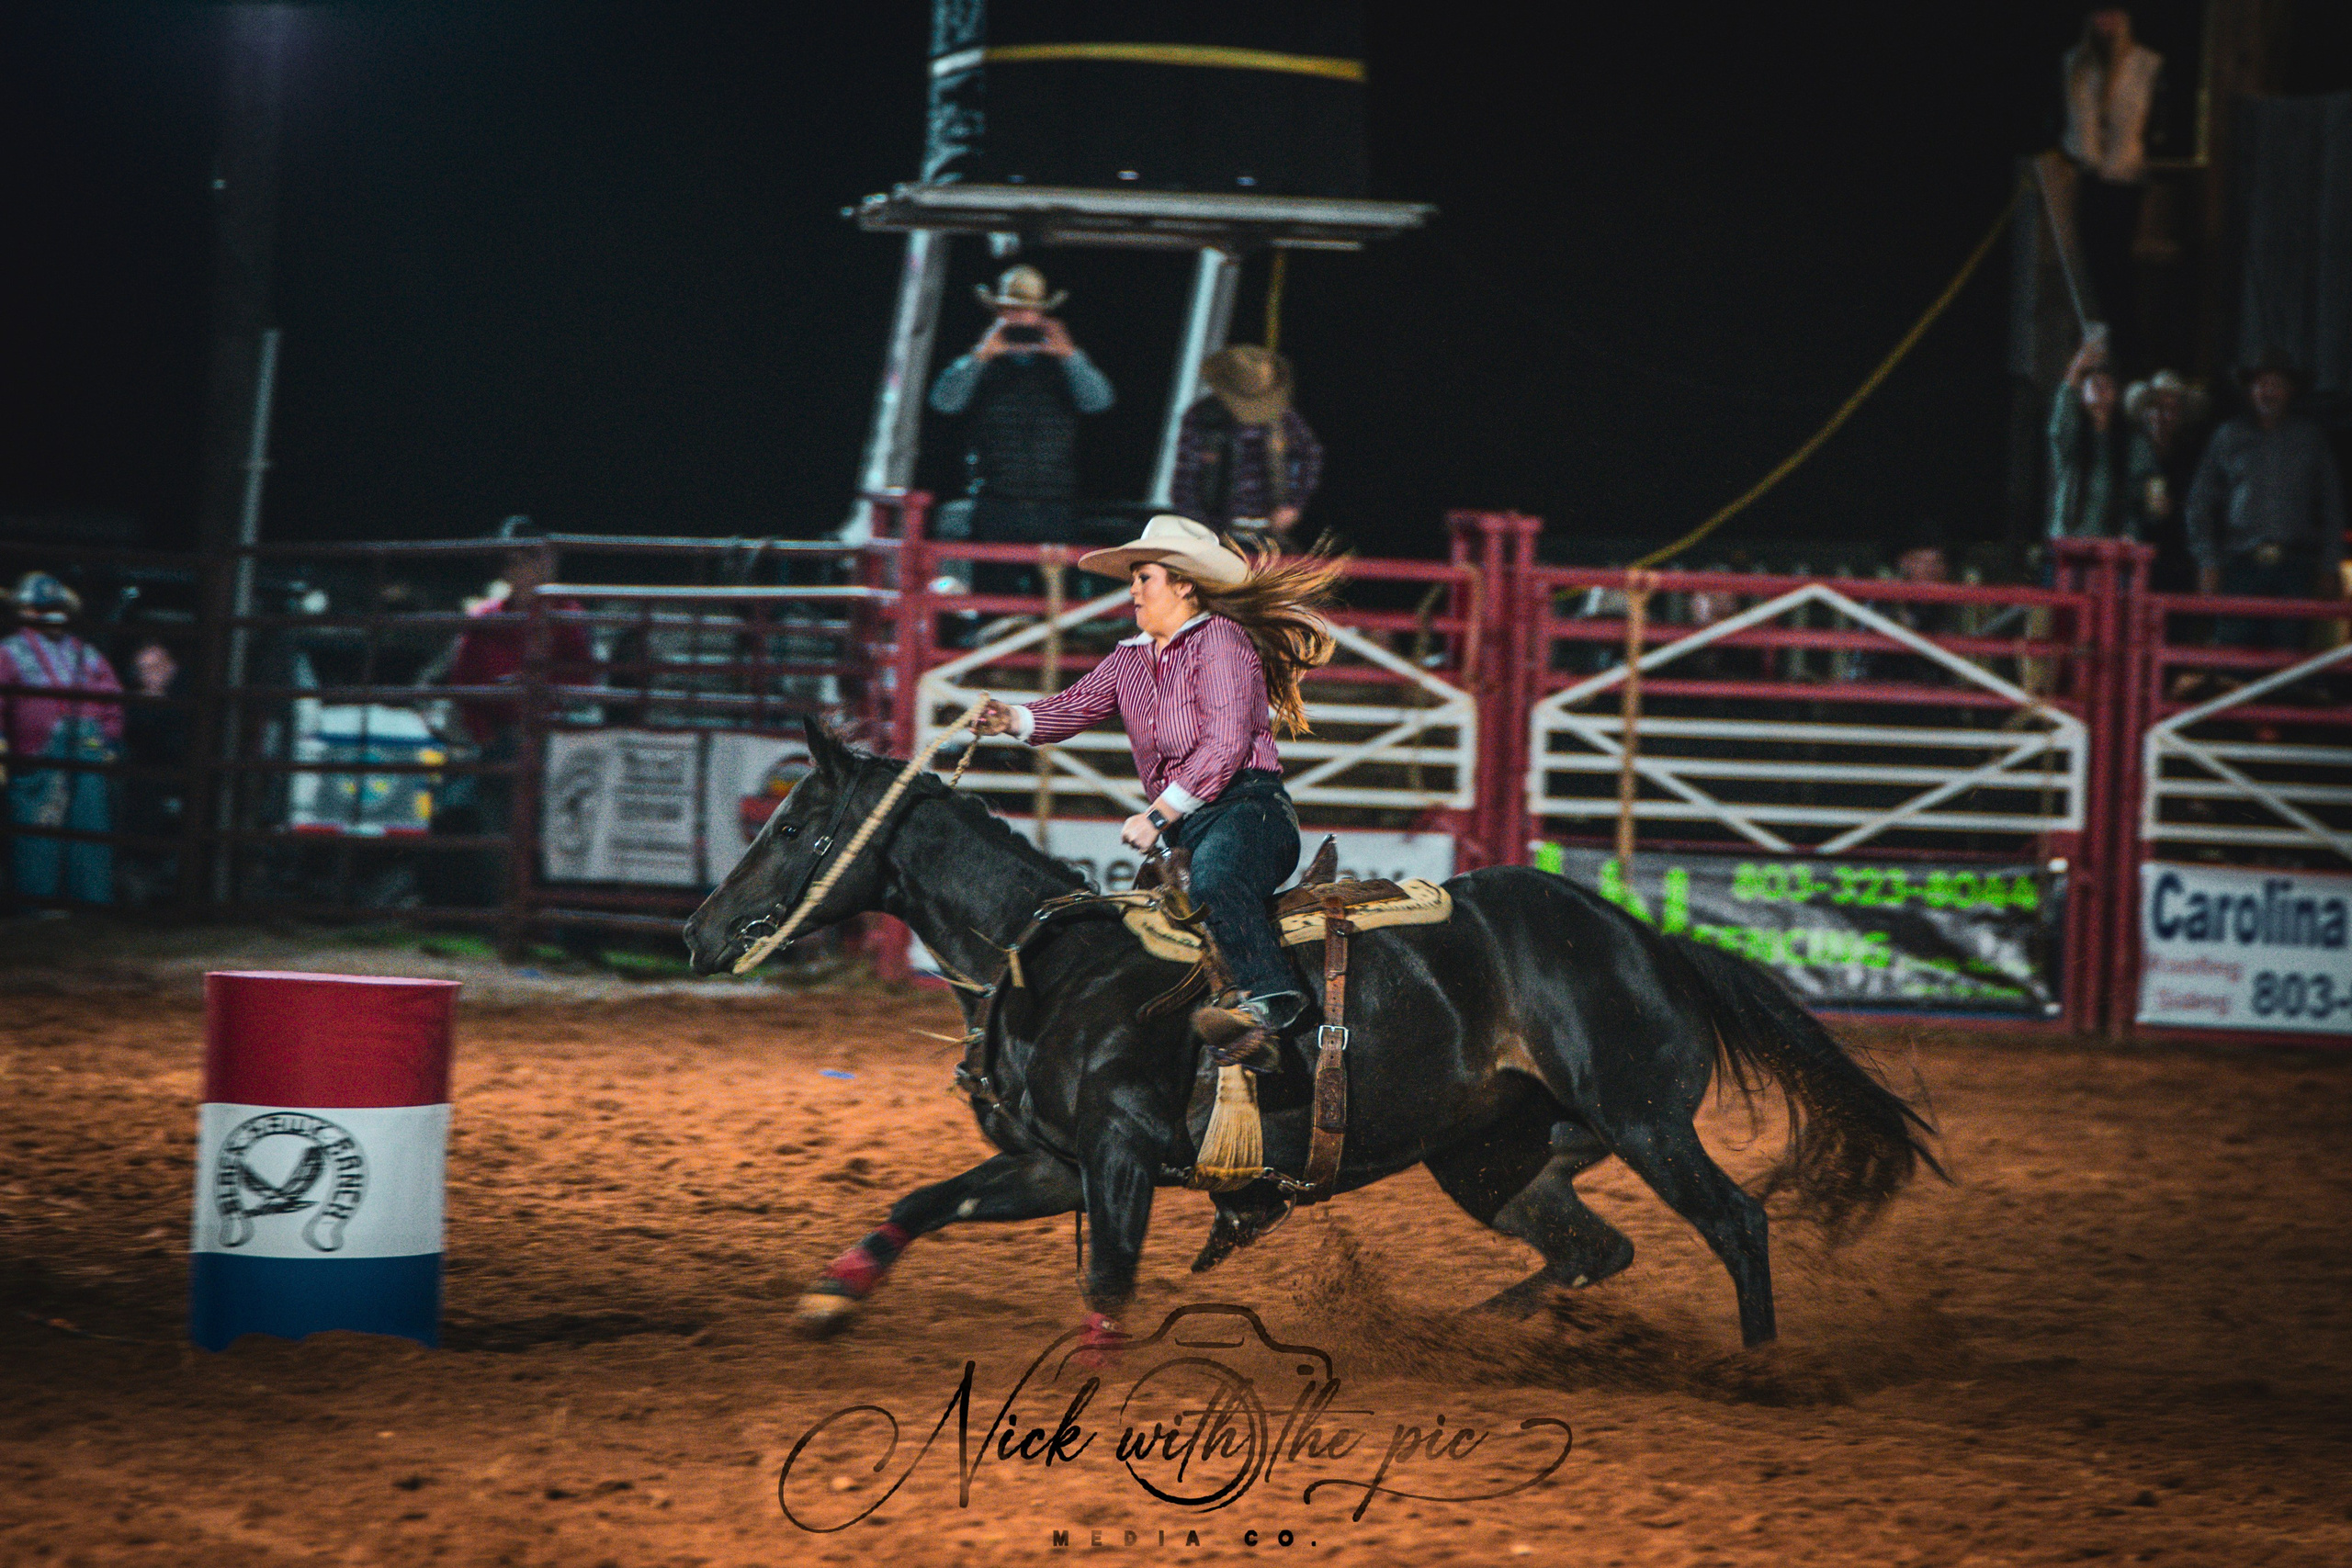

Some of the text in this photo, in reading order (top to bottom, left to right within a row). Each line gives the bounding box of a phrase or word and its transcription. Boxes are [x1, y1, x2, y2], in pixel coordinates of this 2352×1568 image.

[1732, 863, 2039, 911] 803-323-8044
[2154, 874, 2346, 948] Carolina
[2254, 971, 2352, 1019] 803-
[322, 1136, 364, 1220] RANCH
